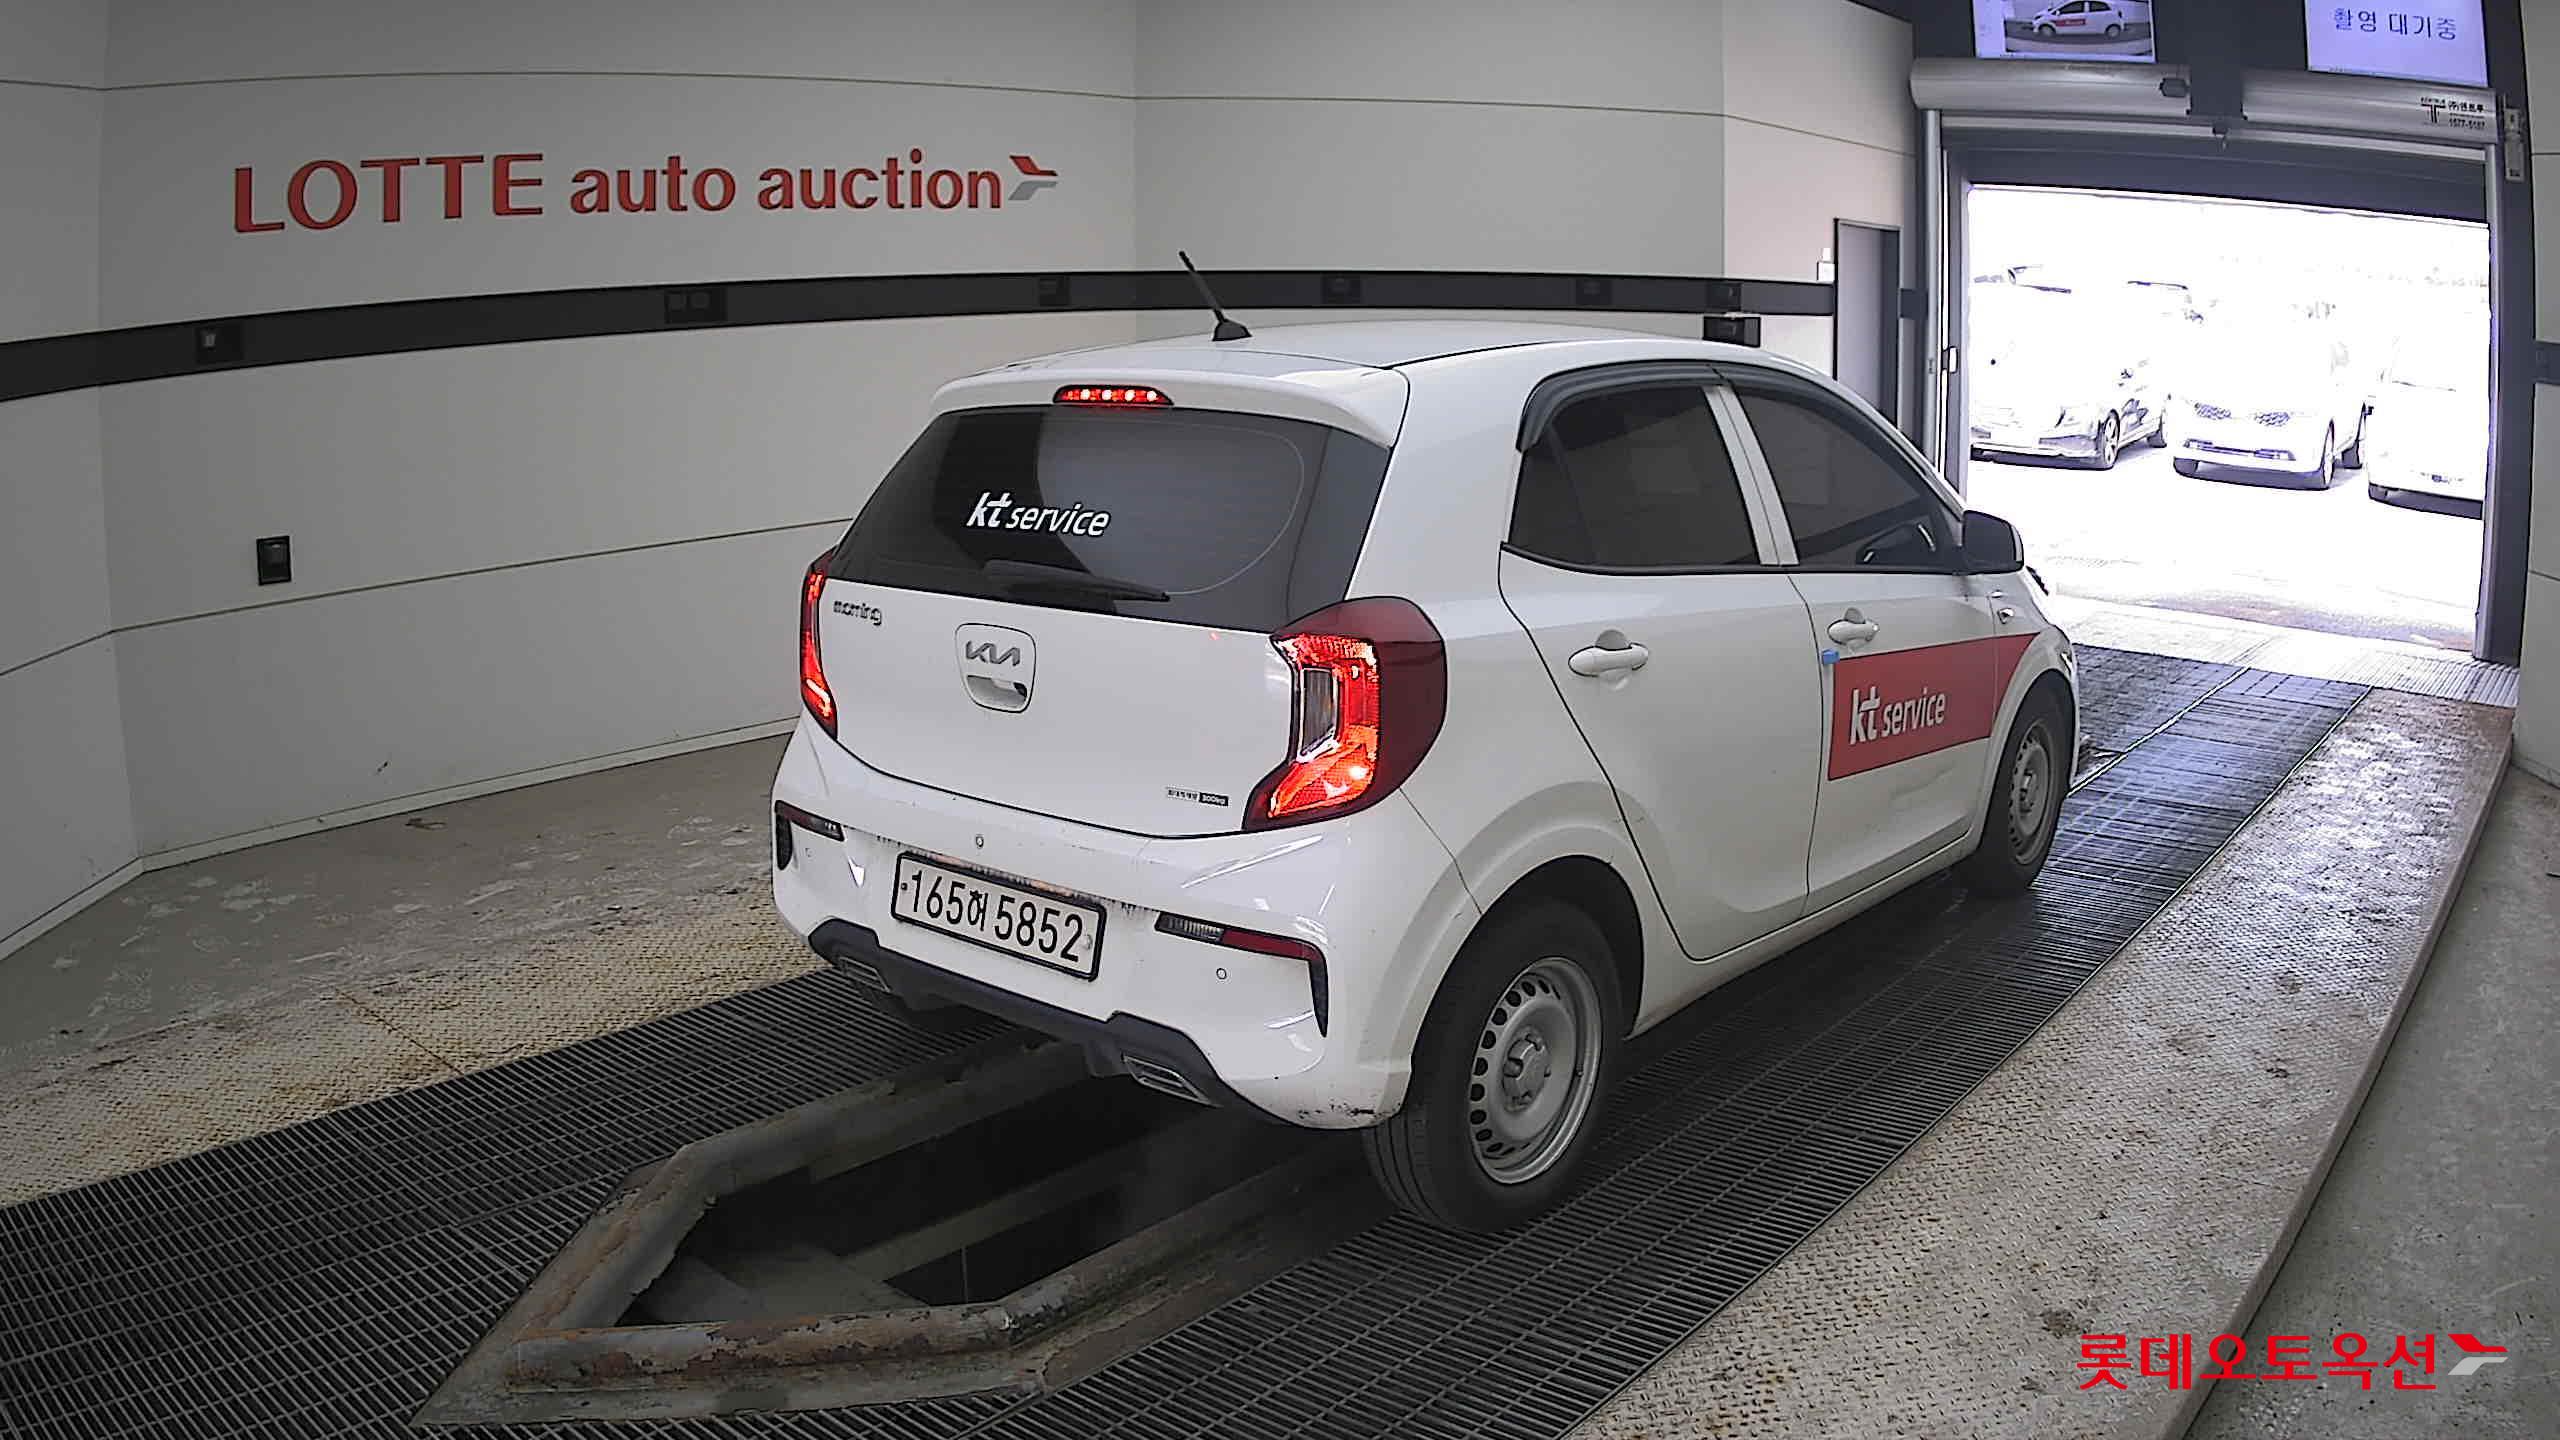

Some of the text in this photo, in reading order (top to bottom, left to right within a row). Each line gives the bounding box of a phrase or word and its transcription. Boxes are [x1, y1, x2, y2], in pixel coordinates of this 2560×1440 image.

[2388, 13, 2457, 41] 대기중
[234, 147, 1002, 234] LOTTE auto auction
[965, 491, 1111, 537] kt service
[965, 640, 1021, 667] KIA
[1849, 685, 1947, 746] kt service
[994, 894, 1083, 963] 5852
